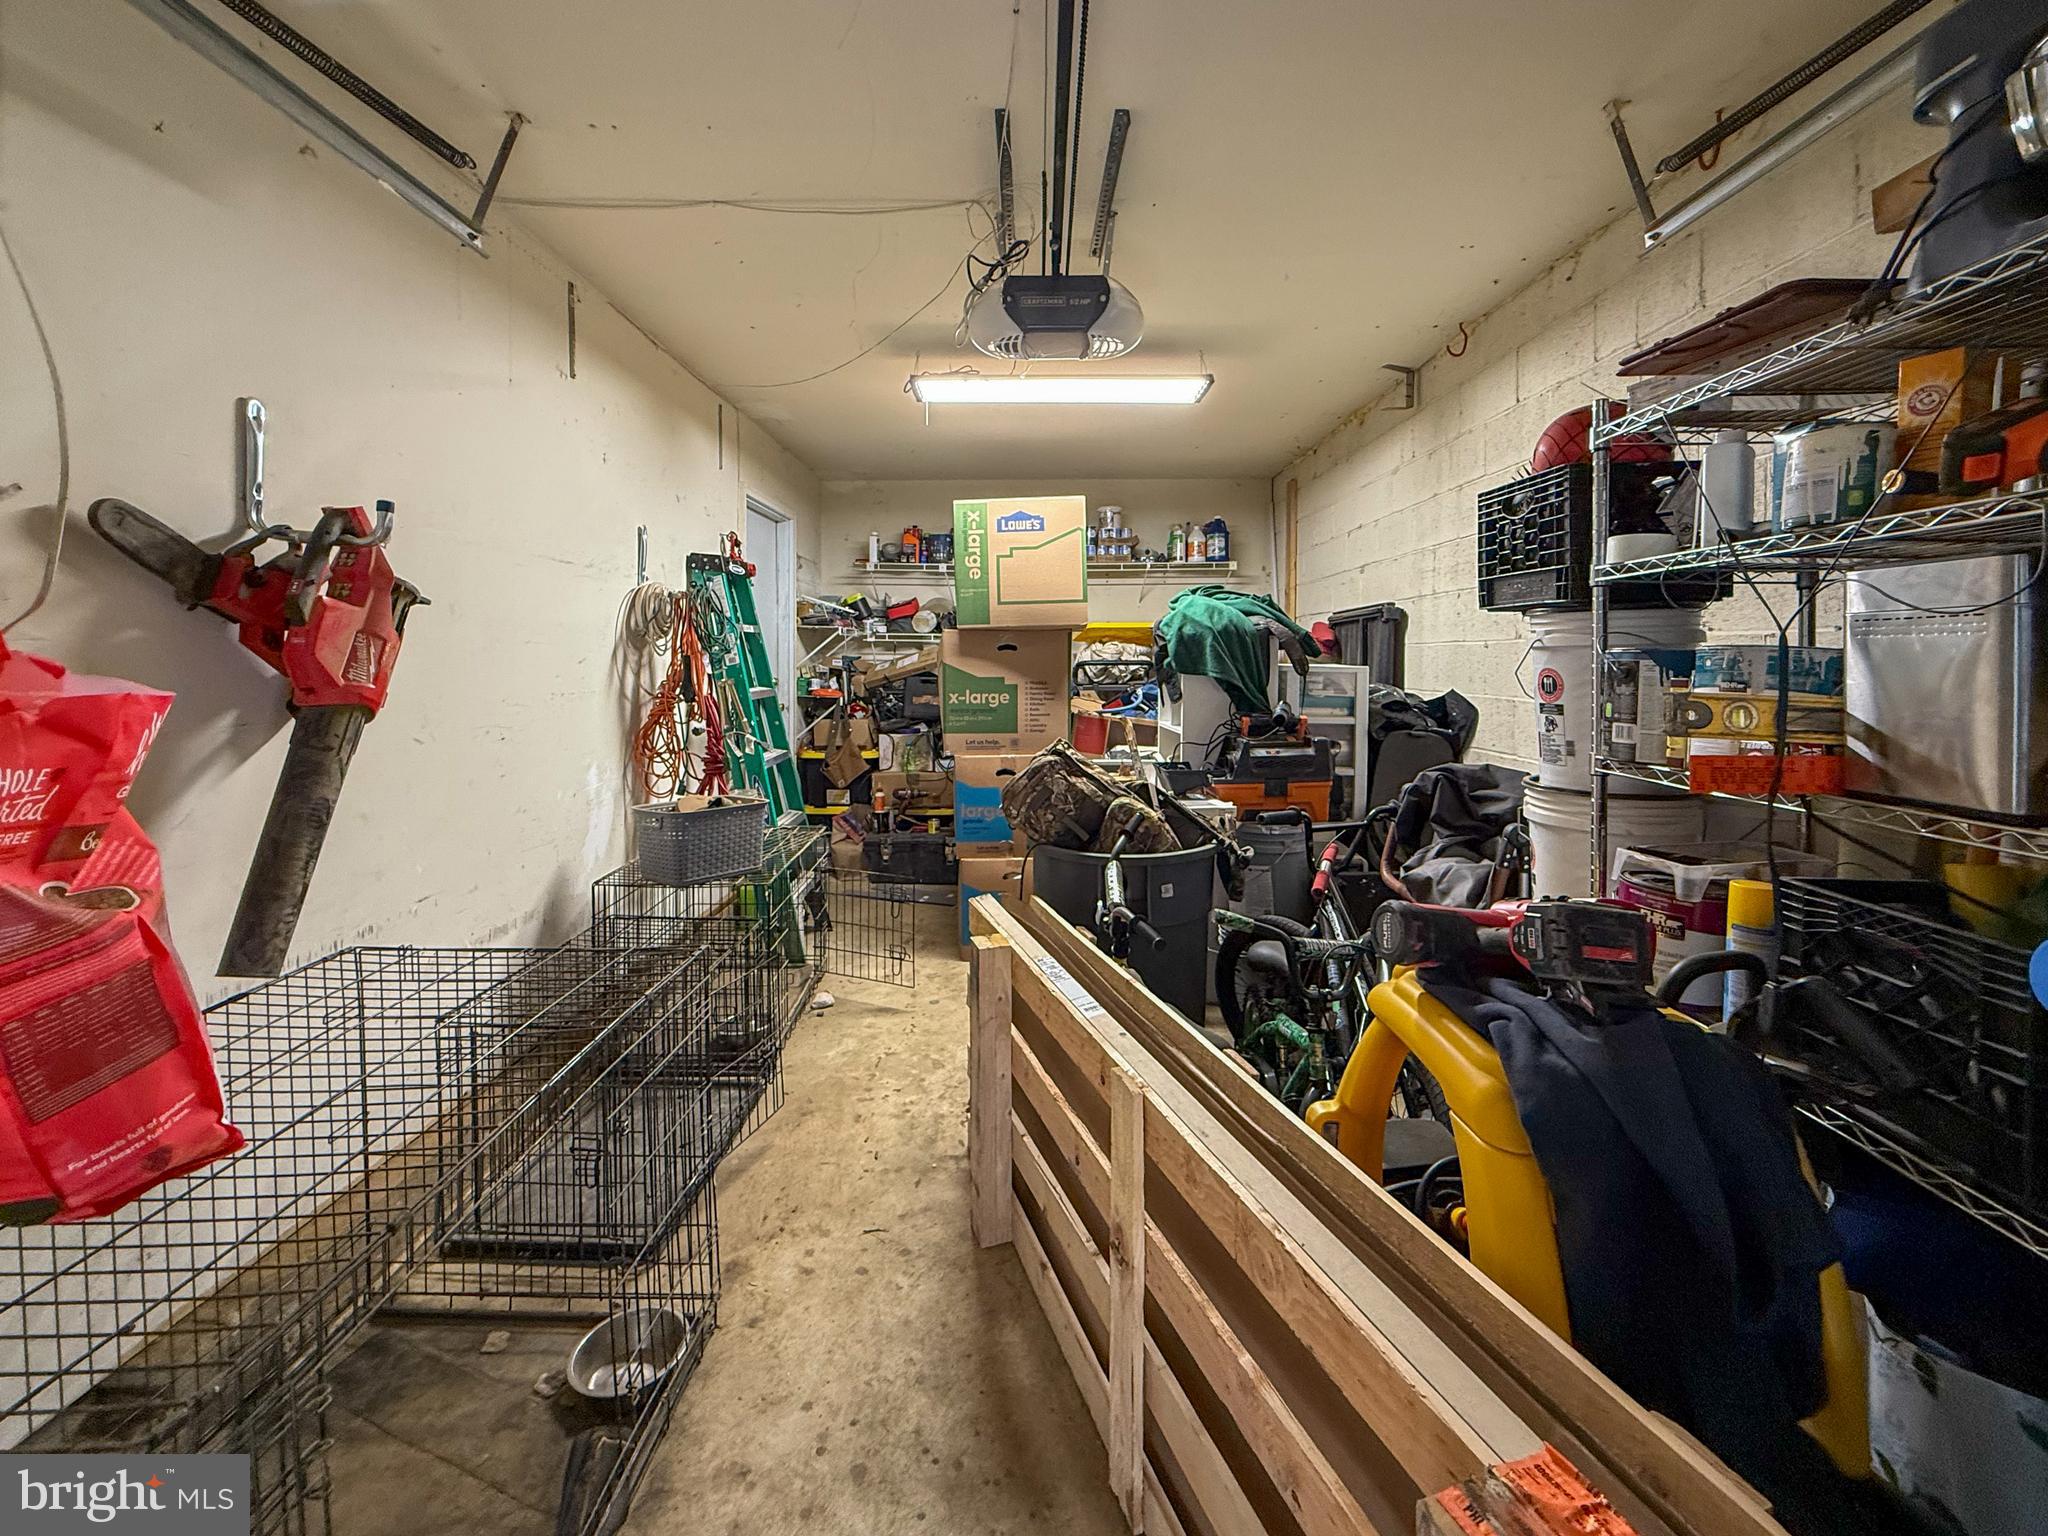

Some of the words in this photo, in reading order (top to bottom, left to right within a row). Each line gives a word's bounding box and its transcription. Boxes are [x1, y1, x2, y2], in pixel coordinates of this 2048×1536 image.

[1001, 518, 1041, 532] LOWE'S
[965, 510, 984, 580] x-large
[948, 689, 1010, 708] x-large
